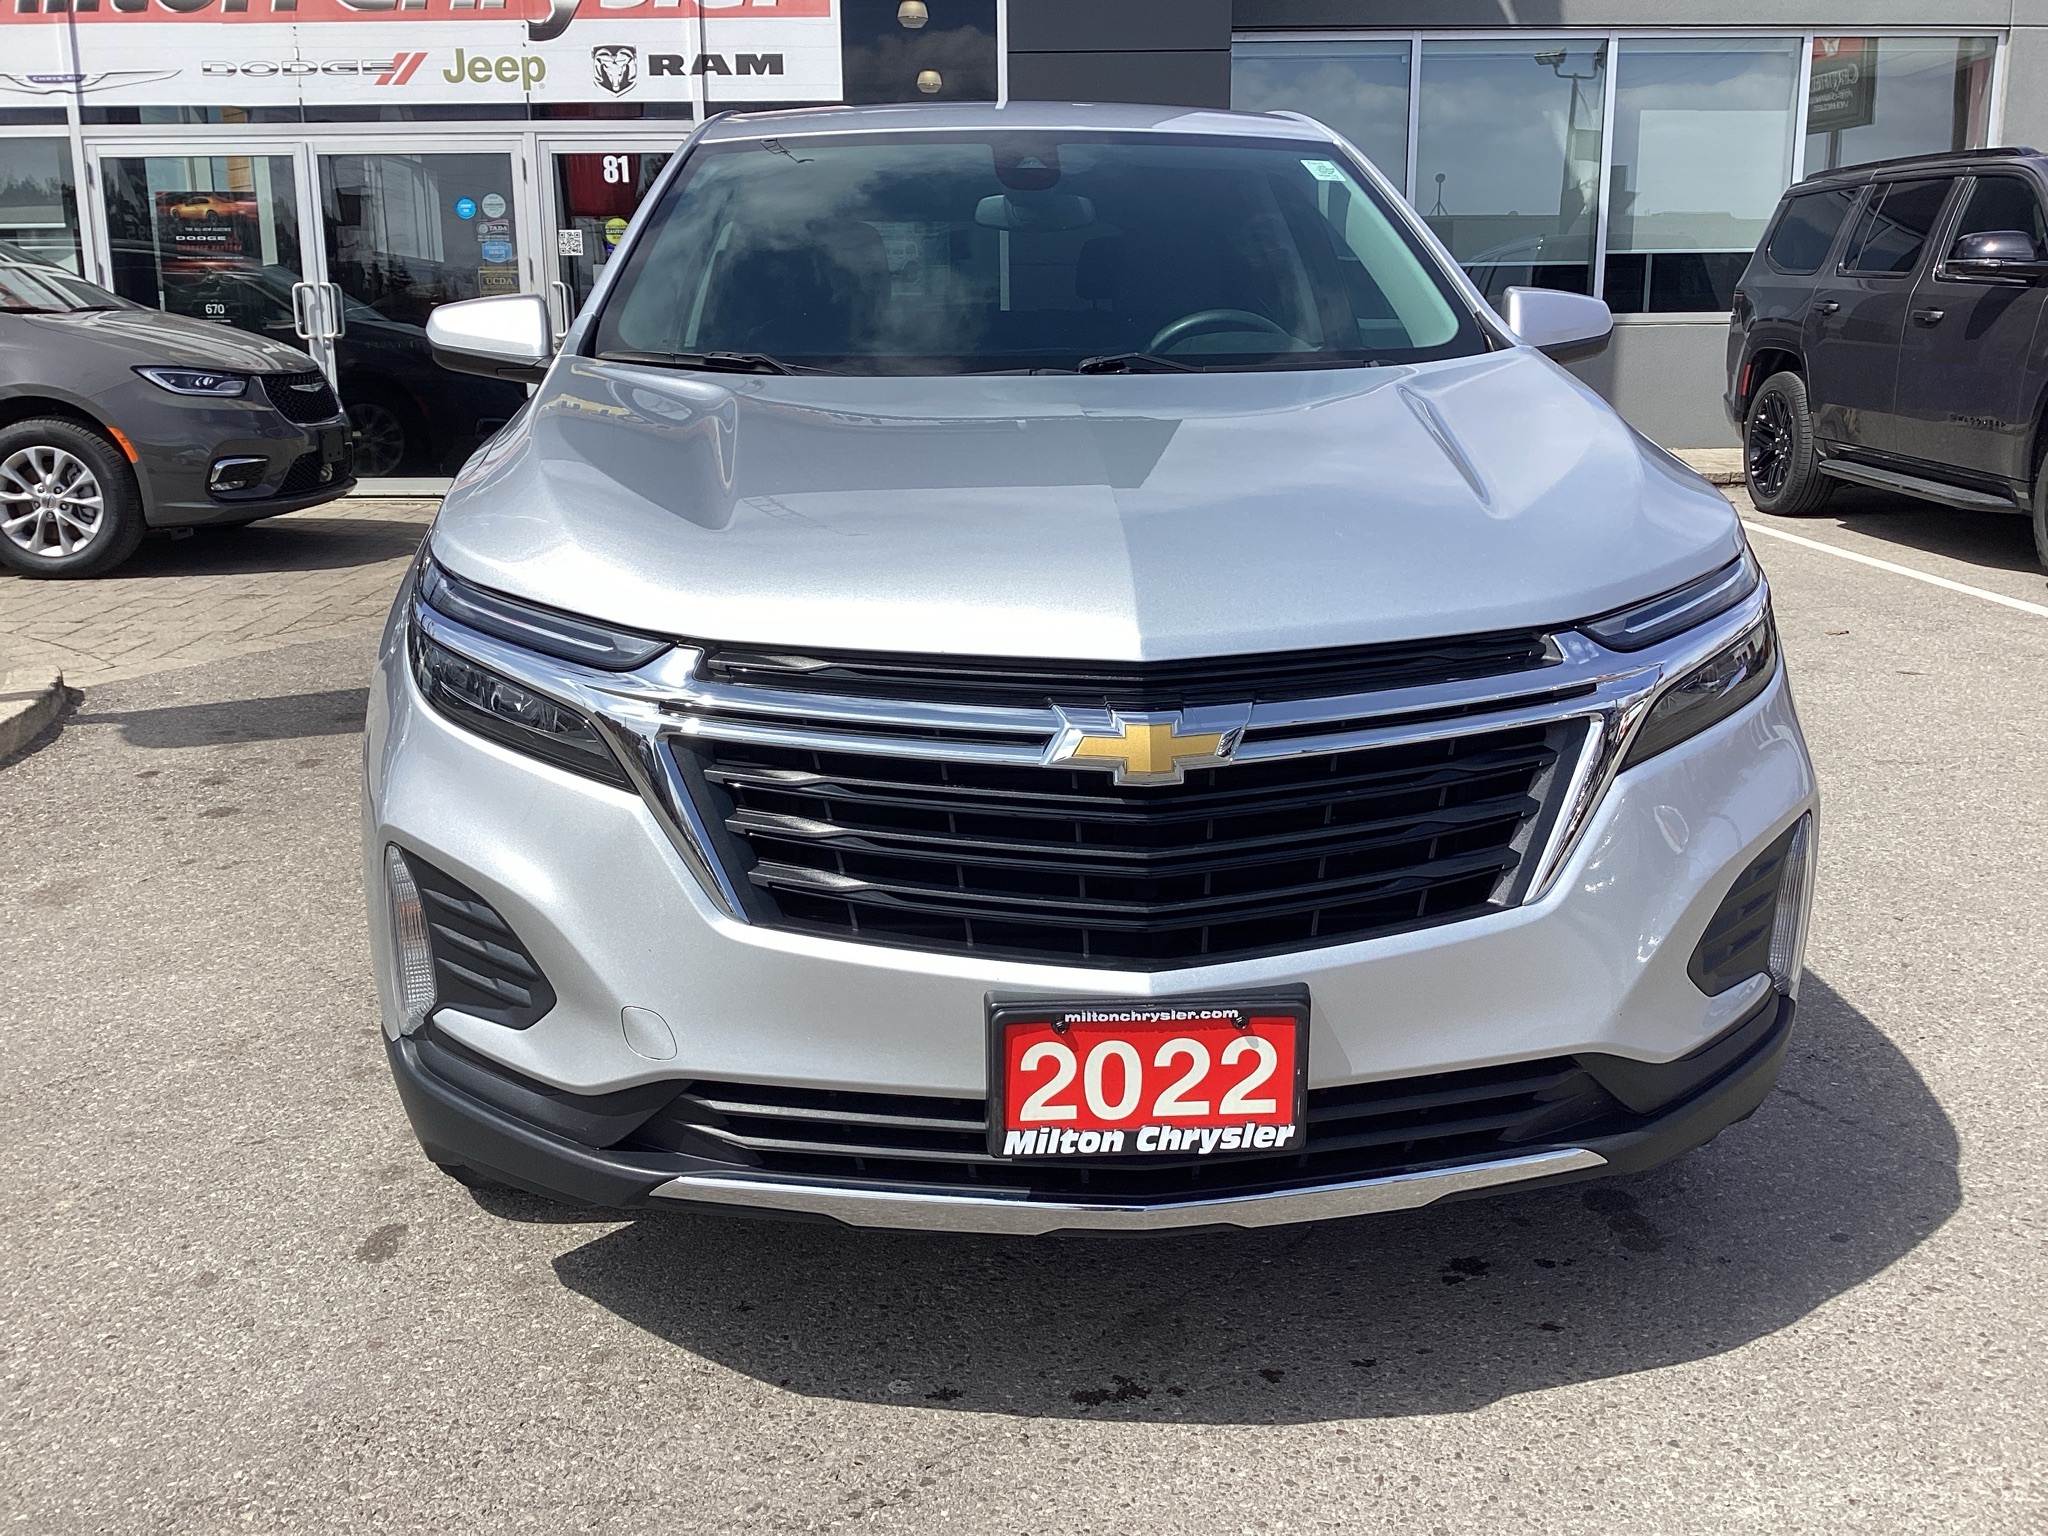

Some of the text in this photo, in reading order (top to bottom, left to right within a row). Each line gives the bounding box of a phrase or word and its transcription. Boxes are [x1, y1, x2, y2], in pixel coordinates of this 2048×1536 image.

[201, 59, 396, 77] DODGE
[443, 48, 546, 90] Jeep
[648, 54, 784, 76] RAM
[603, 155, 630, 183] 81
[486, 277, 513, 285] UCDA
[205, 303, 225, 314] 670
[1065, 1009, 1239, 1023] miltonchrysler.com
[1019, 1035, 1278, 1122] 2022
[1003, 1122, 1296, 1156] Milton Chrysler
